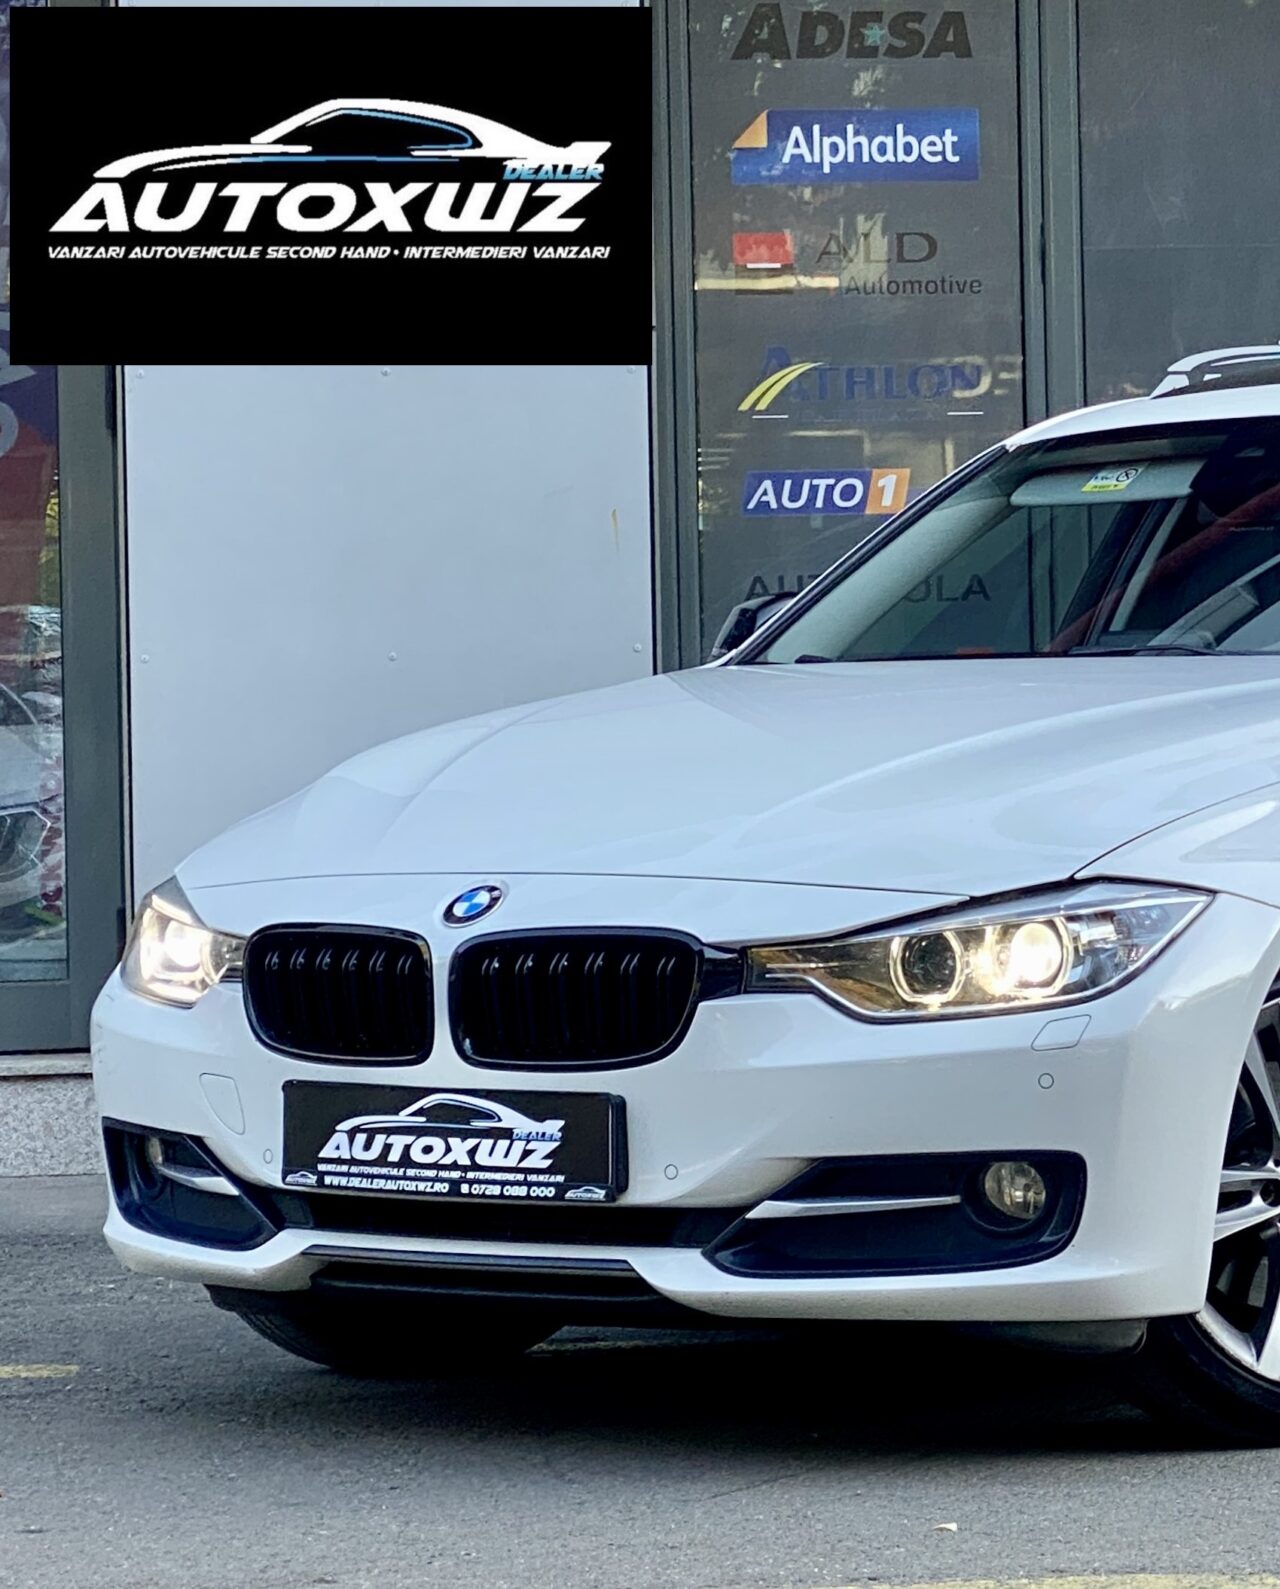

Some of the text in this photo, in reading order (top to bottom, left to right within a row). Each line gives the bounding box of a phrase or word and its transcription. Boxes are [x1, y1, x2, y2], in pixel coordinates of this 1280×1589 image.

[730, 3, 973, 60] ADESA
[782, 124, 960, 173] Alphabet
[816, 232, 938, 264] ALD
[844, 274, 982, 296] Automotive
[747, 474, 898, 510] AUTO 1
[512, 1128, 563, 1142] DEALER
